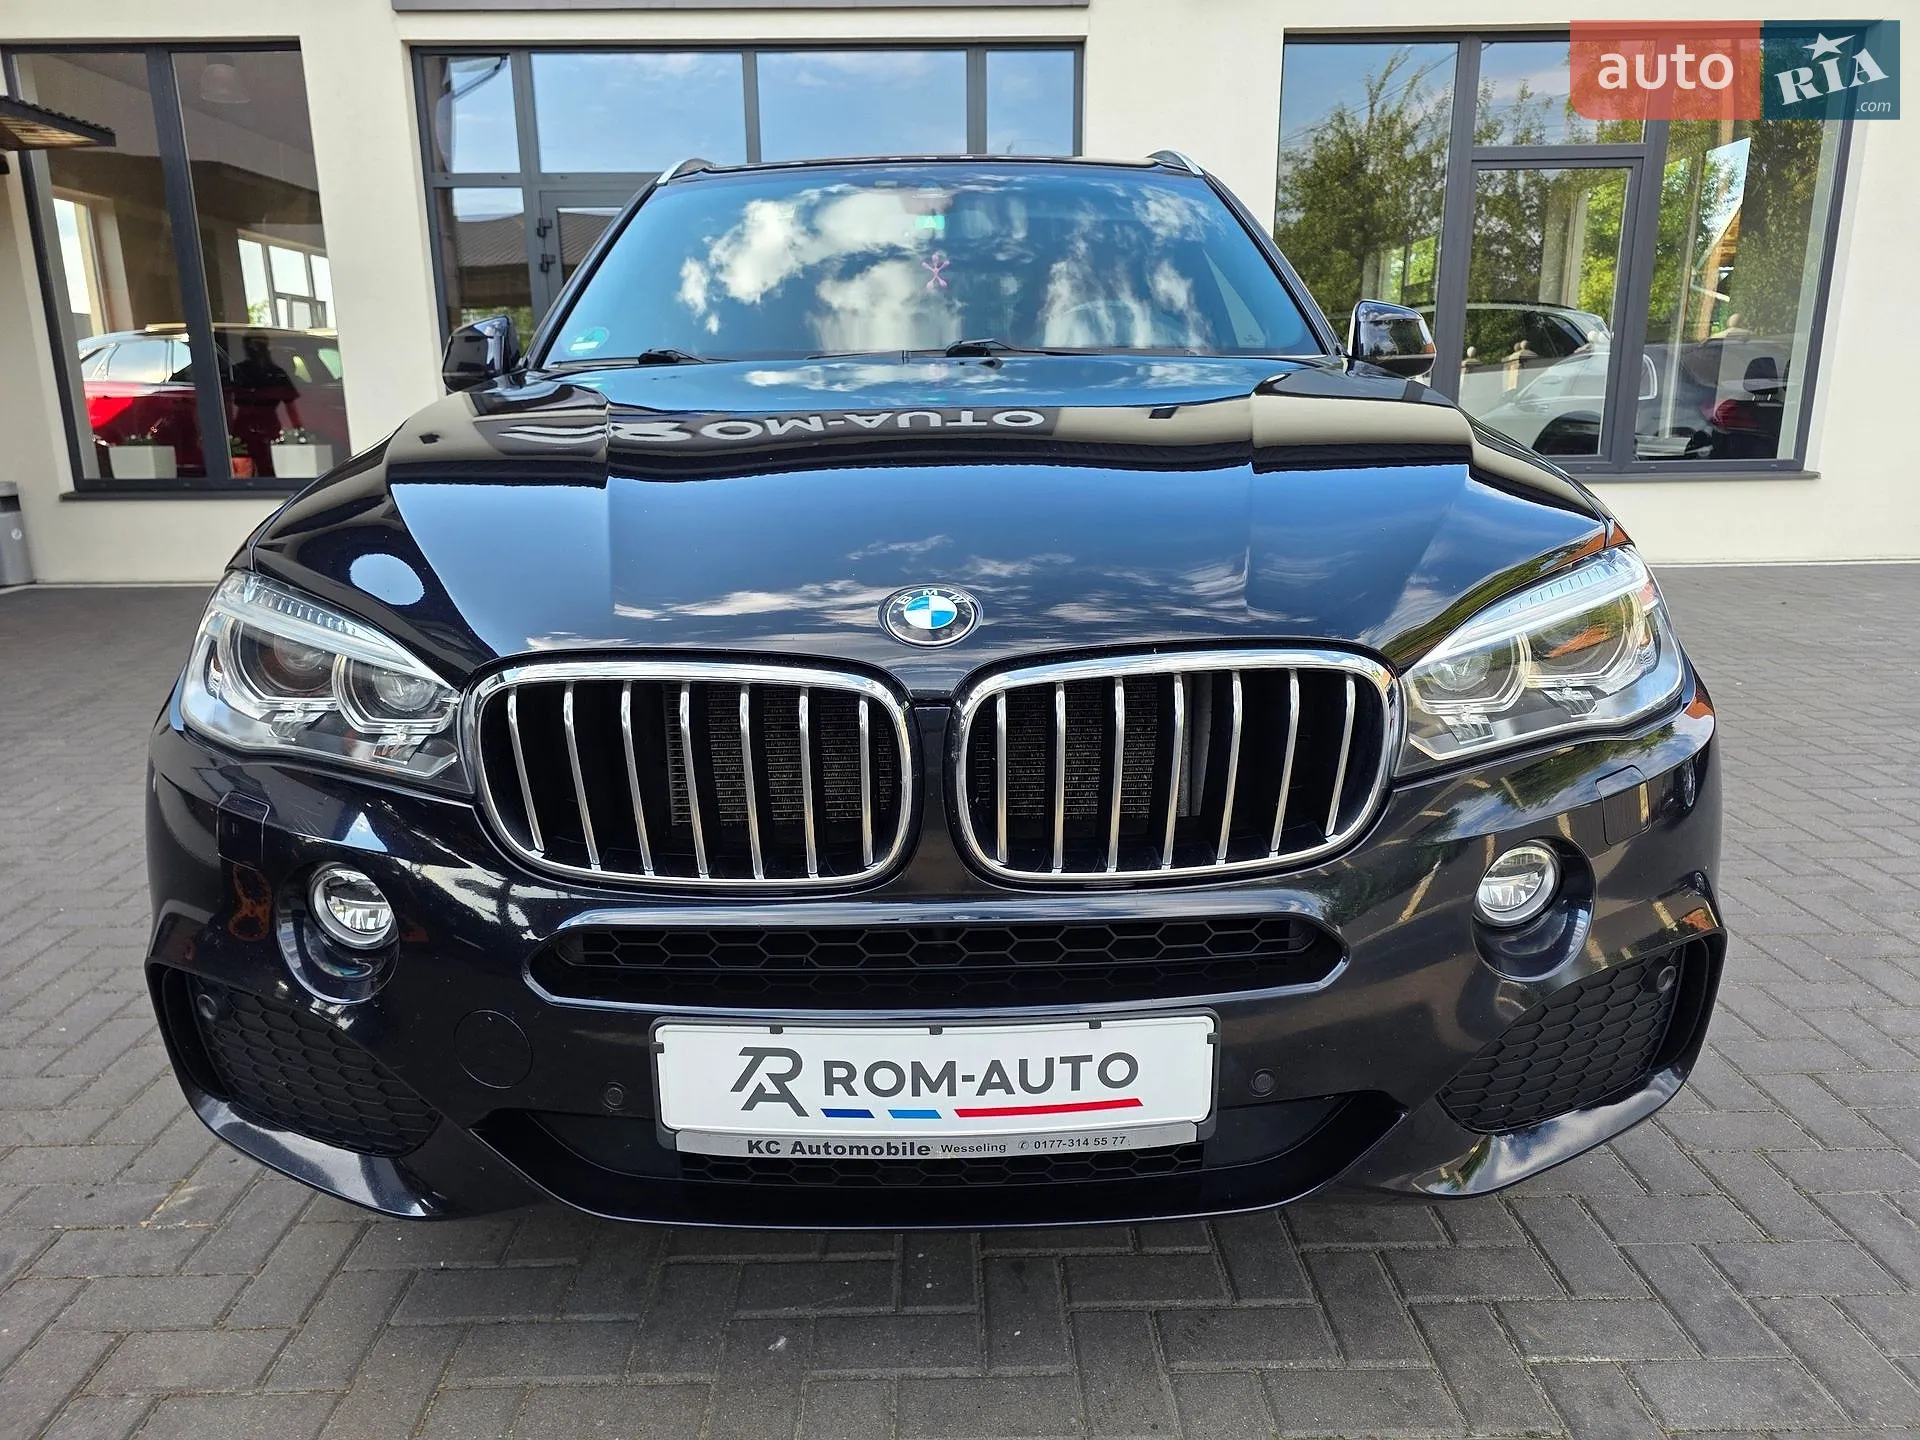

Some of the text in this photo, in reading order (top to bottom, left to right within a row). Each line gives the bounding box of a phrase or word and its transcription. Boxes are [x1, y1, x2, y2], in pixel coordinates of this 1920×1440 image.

[896, 589, 966, 605] BMW
[823, 1051, 1139, 1098] ROM-AUTO
[747, 1136, 1126, 1156] KC Automobile Wesseling 0177-314 55 77
